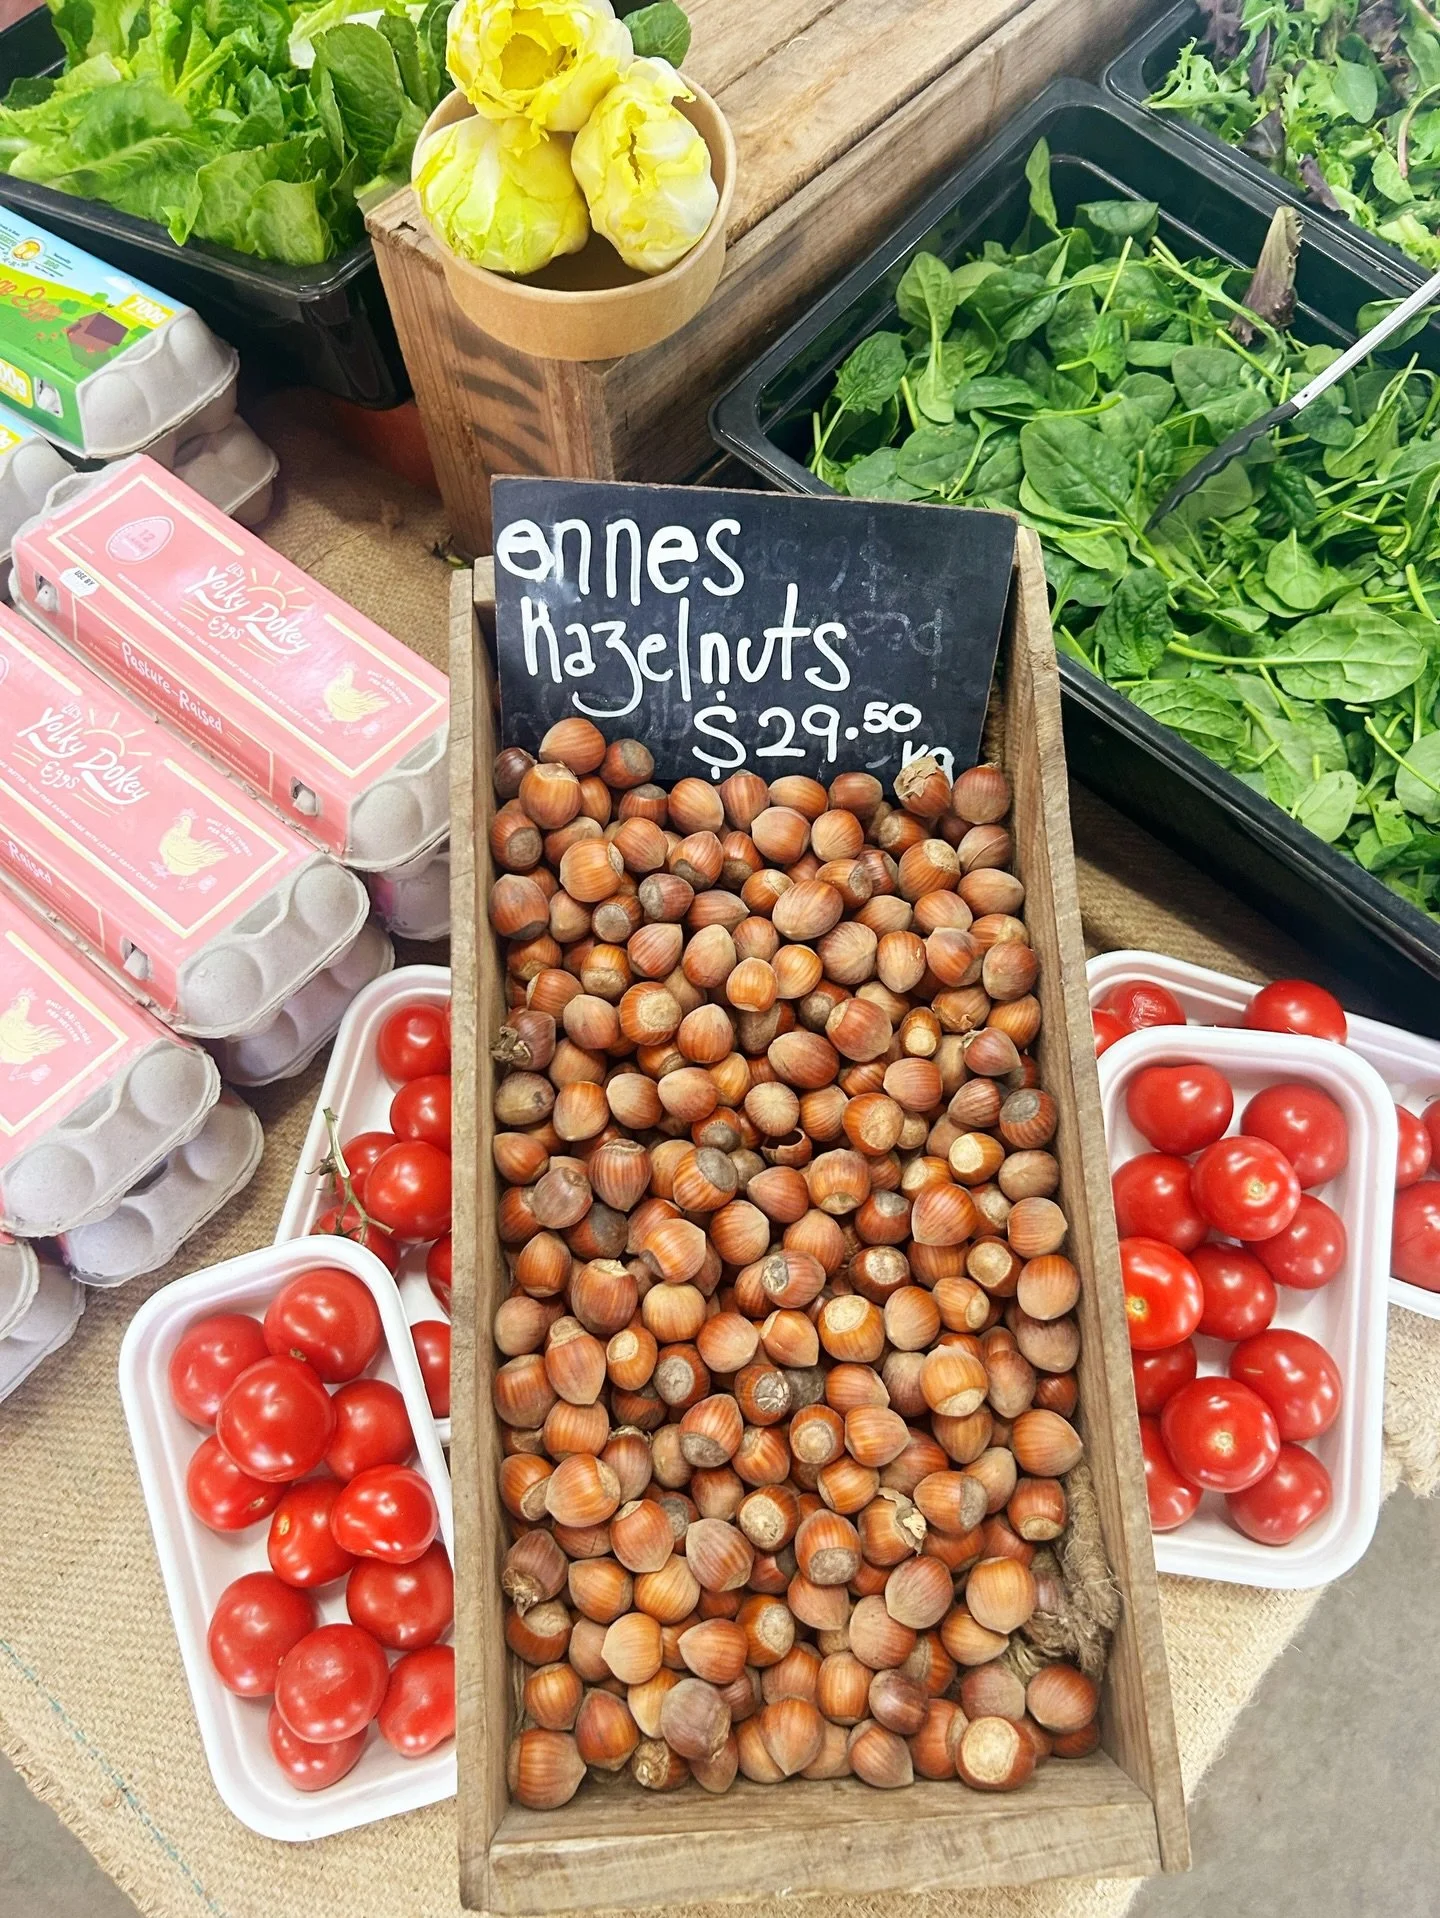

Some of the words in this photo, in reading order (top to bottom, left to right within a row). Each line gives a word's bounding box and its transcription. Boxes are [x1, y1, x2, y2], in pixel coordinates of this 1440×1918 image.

[74, 570, 87, 581] USE
[84, 578, 96, 587] BY
[184, 566, 251, 614] Yolky
[238, 602, 312, 655] Dokey
[208, 615, 245, 640] Eggs
[521, 582, 851, 717] hazelnuts
[121, 641, 223, 734] Pasture-Raised
[16, 707, 87, 758] Yolky
[73, 748, 151, 805] Dokey
[40, 761, 80, 789] Eggs
